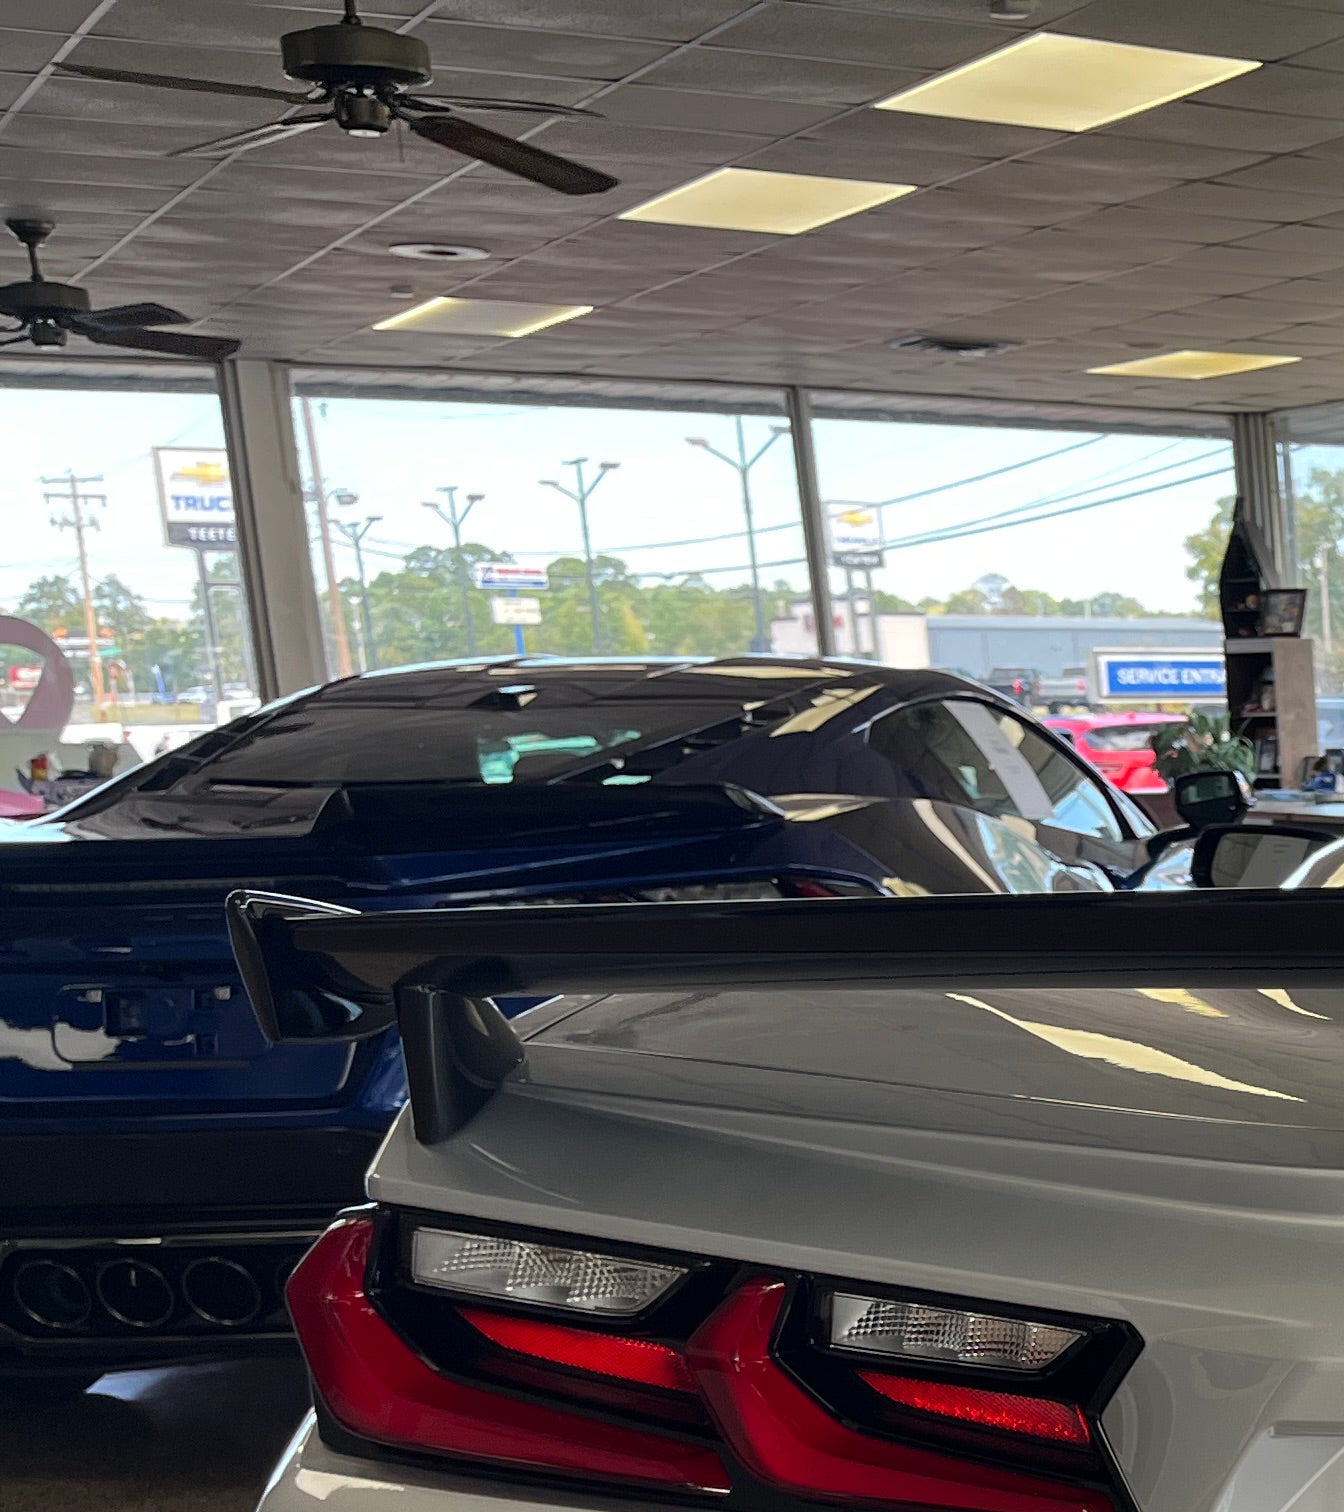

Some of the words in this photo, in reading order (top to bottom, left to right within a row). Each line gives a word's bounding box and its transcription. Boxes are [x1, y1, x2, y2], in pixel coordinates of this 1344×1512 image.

[171, 495, 232, 511] TRUC
[188, 526, 235, 541] TEETE
[1117, 667, 1179, 685] SERVICE
